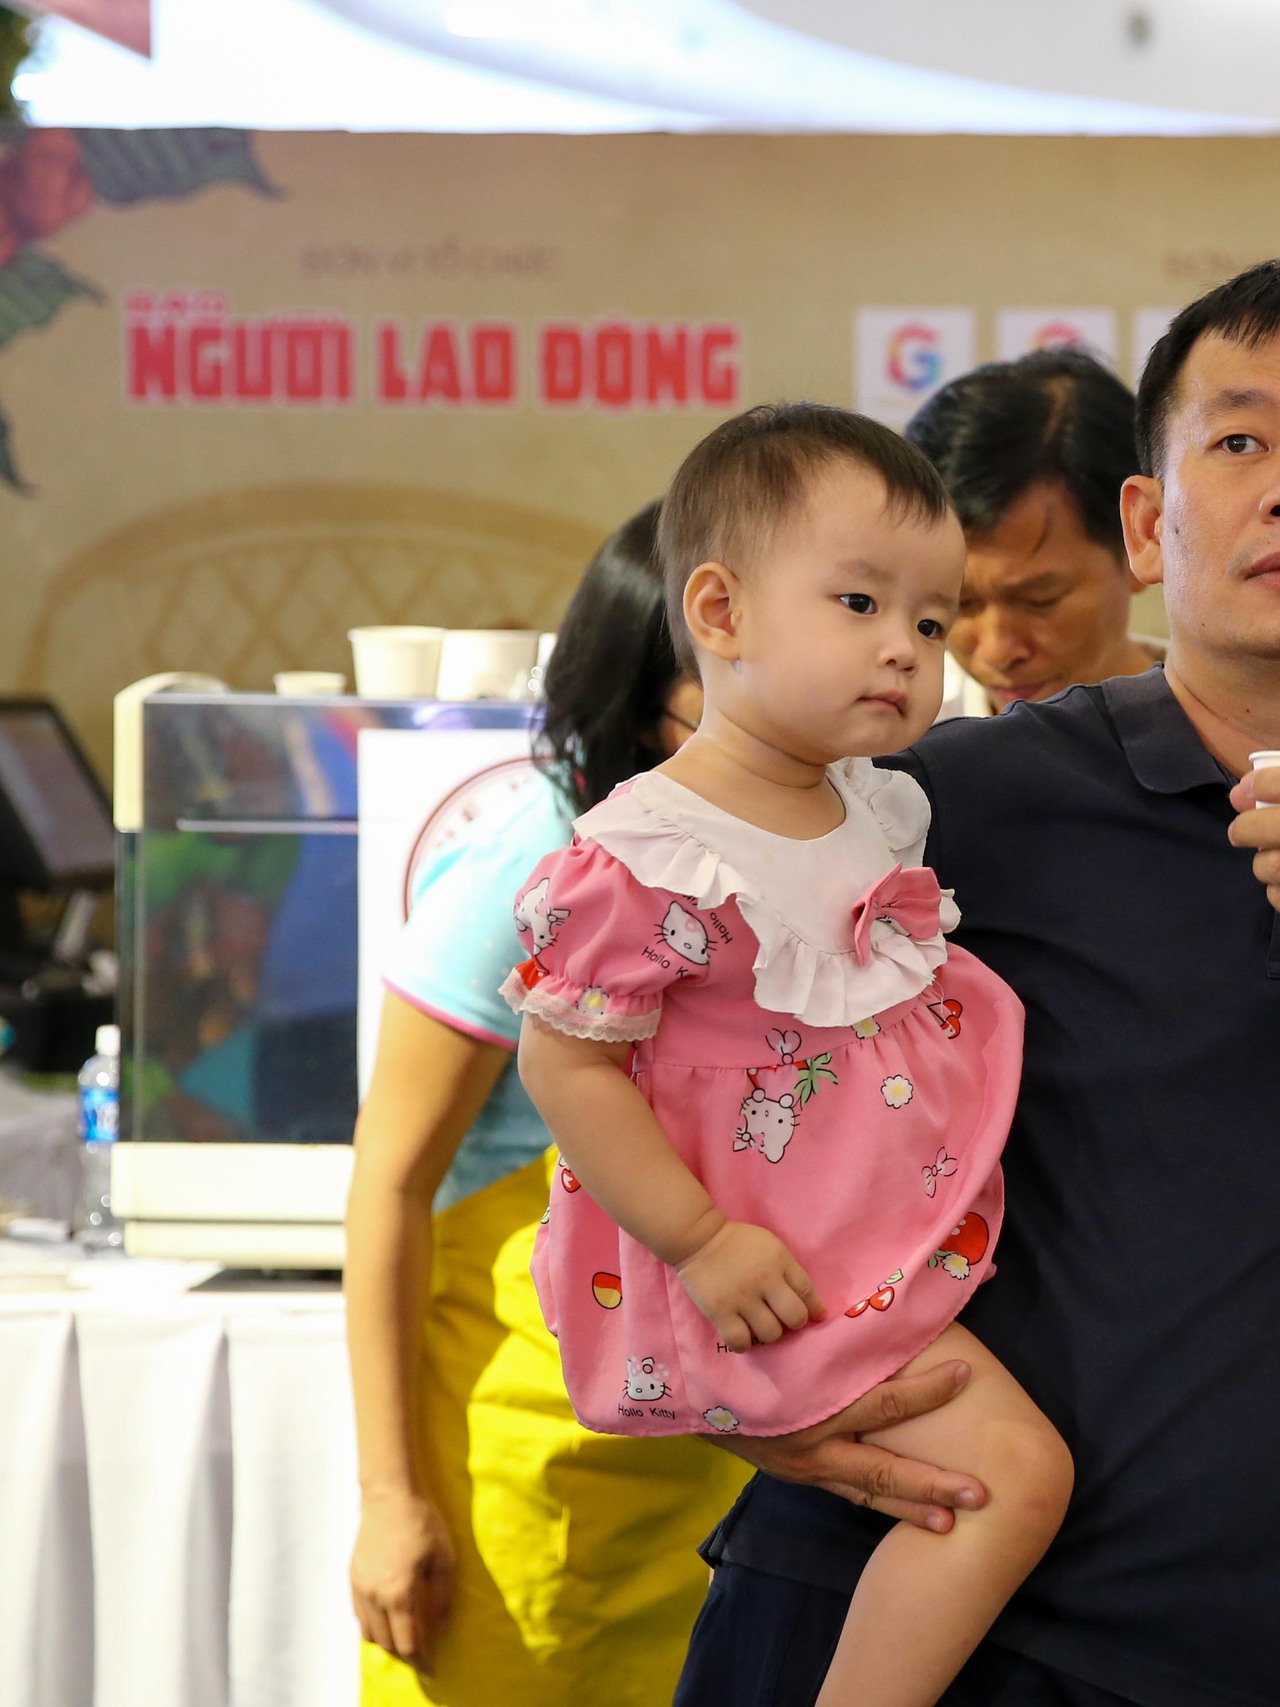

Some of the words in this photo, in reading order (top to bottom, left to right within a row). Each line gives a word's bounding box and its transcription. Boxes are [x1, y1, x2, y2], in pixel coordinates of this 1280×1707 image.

[377, 324, 515, 402] LAO
[543, 319, 738, 410] ĐỘNG
[648, 1407, 676, 1420] Kitty
